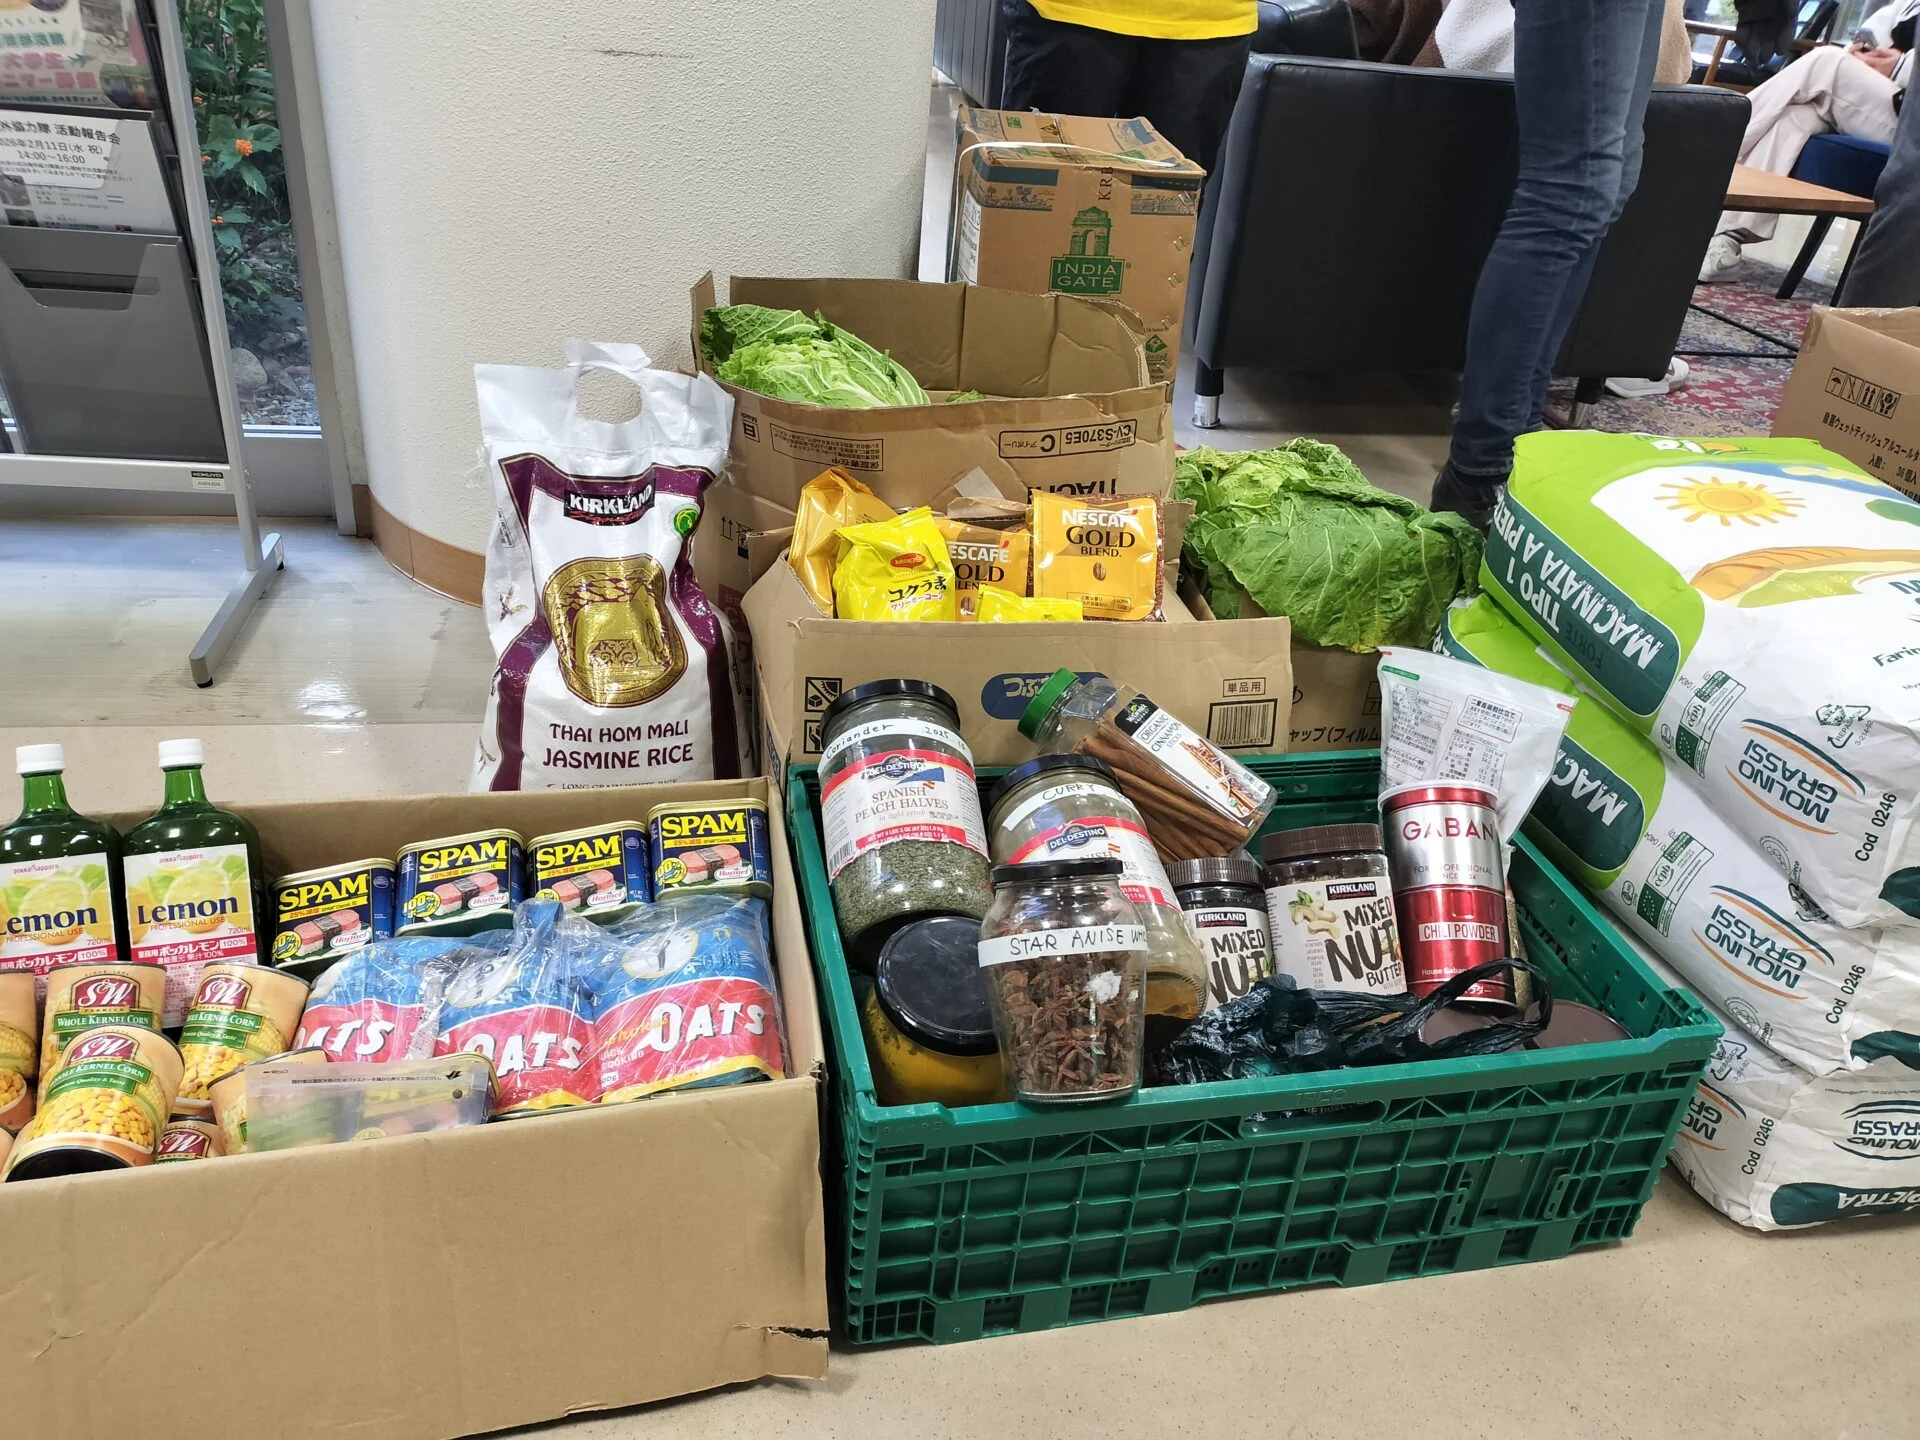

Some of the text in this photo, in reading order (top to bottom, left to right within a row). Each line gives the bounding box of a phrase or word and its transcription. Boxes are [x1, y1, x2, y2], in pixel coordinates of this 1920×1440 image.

[1056, 262, 1117, 275] INDIA
[1057, 275, 1115, 289] GATE
[1040, 433, 1056, 453] C
[570, 484, 652, 515] KIRKLAND
[1065, 526, 1136, 549] GOLD
[950, 540, 1010, 563] ESCAFÉ
[954, 562, 1006, 583] OLD
[1520, 577, 1560, 634] TIPO
[1523, 535, 1545, 563] A
[1539, 549, 1664, 672] MACINATA
[1227, 681, 1262, 693] 単品用
[549, 719, 689, 743] THAI HOM MALI
[1140, 714, 1169, 742] ORGANIC
[1151, 722, 1182, 753] CINNAMON
[542, 743, 694, 770] JASMINE RICE
[1744, 739, 1839, 804] GRASSI
[871, 786, 926, 804] SPANISH
[1042, 783, 1095, 801] CURRY
[1738, 761, 1831, 825] MOLINO
[855, 797, 949, 823] PEACH HALVES
[662, 812, 747, 838] SPAM
[1402, 816, 1494, 842] GABAN
[1855, 792, 1898, 863] Cod 0246
[419, 839, 508, 873] SPAM
[536, 834, 622, 870] SPAM
[278, 873, 369, 912] SPAM
[1329, 882, 1376, 893] KIRKLAND
[136, 895, 239, 926] Lemon
[1197, 913, 1246, 923] KIRKLAND
[6, 927, 84, 943] PROFESSIONAL USE
[150, 915, 226, 933] PROFESSIONAL USE
[1423, 923, 1496, 942] CHILI POWDER
[159, 940, 221, 957] ポッカレモン
[222, 938, 247, 949] 100%
[1010, 927, 1125, 956] STAR ANISE
[1324, 919, 1398, 983] NUT
[1711, 904, 1808, 972] GRASSI
[15, 952, 78, 970] ポッカレモン
[80, 949, 106, 960] 100%
[1703, 923, 1800, 990] MOLINO
[1208, 950, 1268, 1004] NUT
[1366, 961, 1403, 988] BUTTER
[1825, 964, 1866, 1025] Cod 0246
[57, 1013, 149, 1027] WHOLE KERNEL CORN
[229, 1015, 256, 1028] CORN
[631, 1001, 766, 1053] OATS
[75, 1062, 113, 1073] KERNEL
[116, 1063, 145, 1079] CORN
[602, 1050, 645, 1070] COOKING
[77, 1076, 101, 1086] Quality
[108, 1077, 126, 1086] Taste
[1741, 1117, 1775, 1176] Cod 0246
